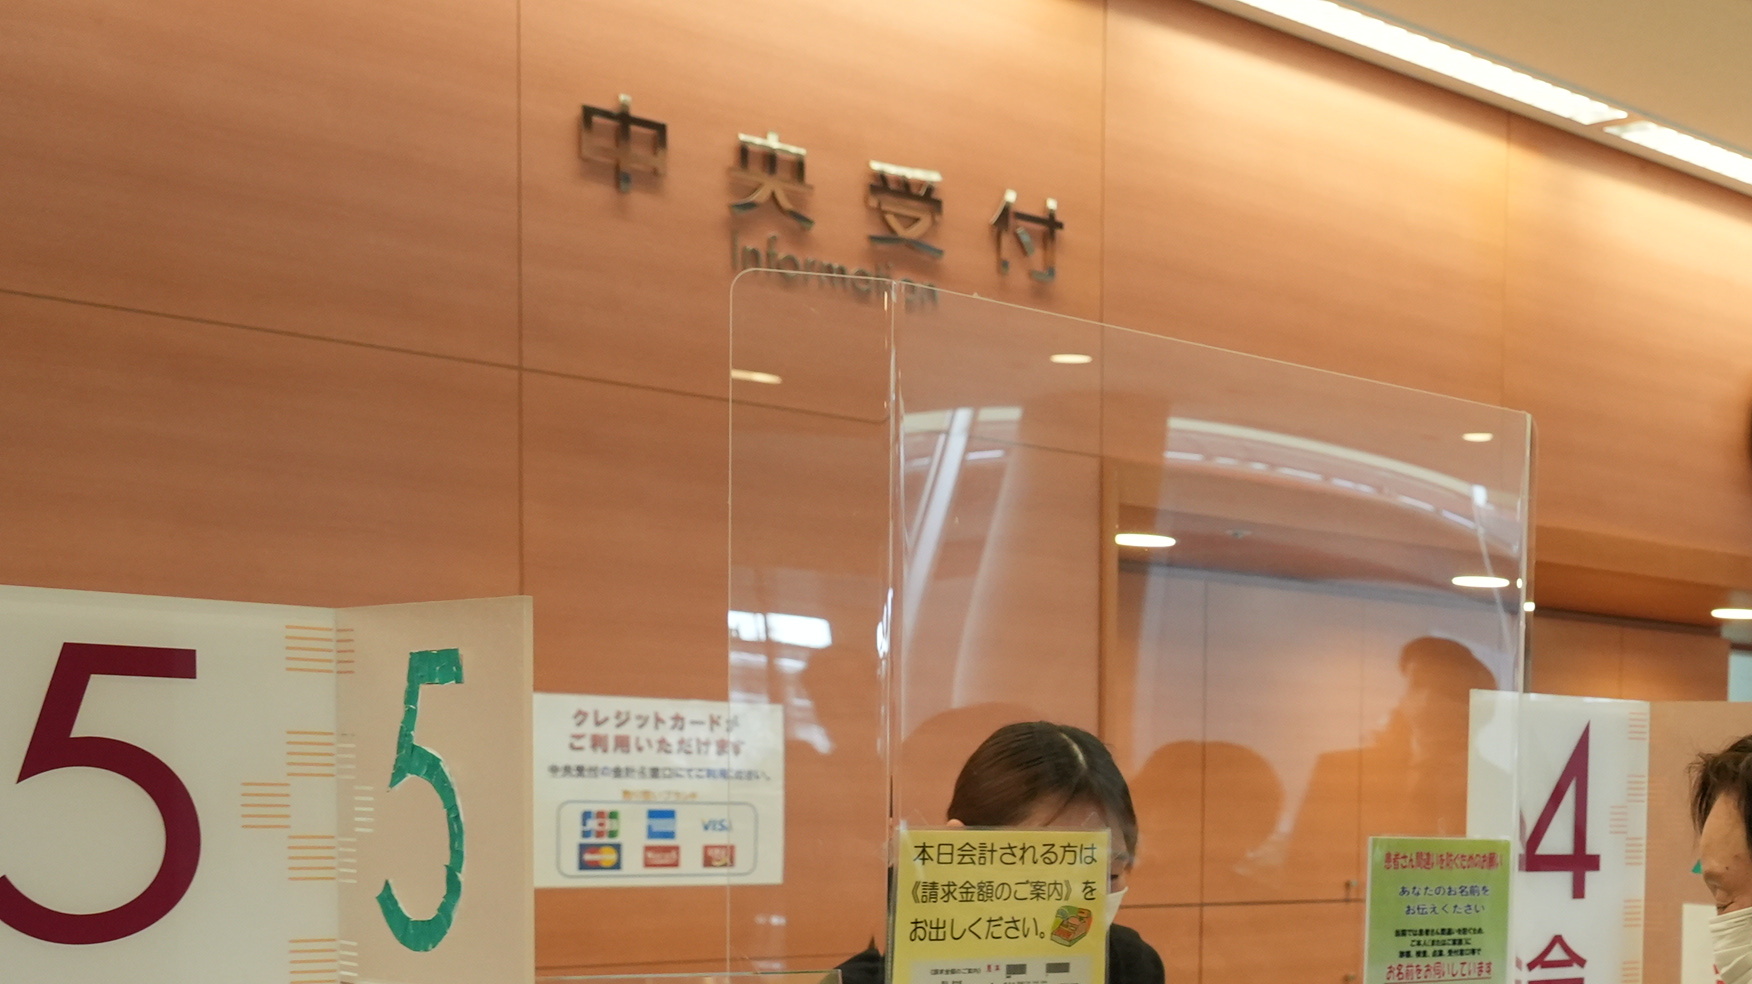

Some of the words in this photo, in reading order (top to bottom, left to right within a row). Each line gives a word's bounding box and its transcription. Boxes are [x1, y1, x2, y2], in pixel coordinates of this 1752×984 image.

[580, 93, 1064, 282] 中央受付
[732, 231, 940, 307] Information
[569, 733, 746, 757] ご利用いただけます
[573, 709, 740, 733] クレジットカードが
[0, 642, 201, 945] 5
[376, 647, 465, 952] 5
[1519, 718, 1601, 899] 4
[912, 841, 1098, 866] 本日会計される方は
[1399, 885, 1490, 897] あなたのお名前を
[908, 916, 1046, 942] お出しください。
